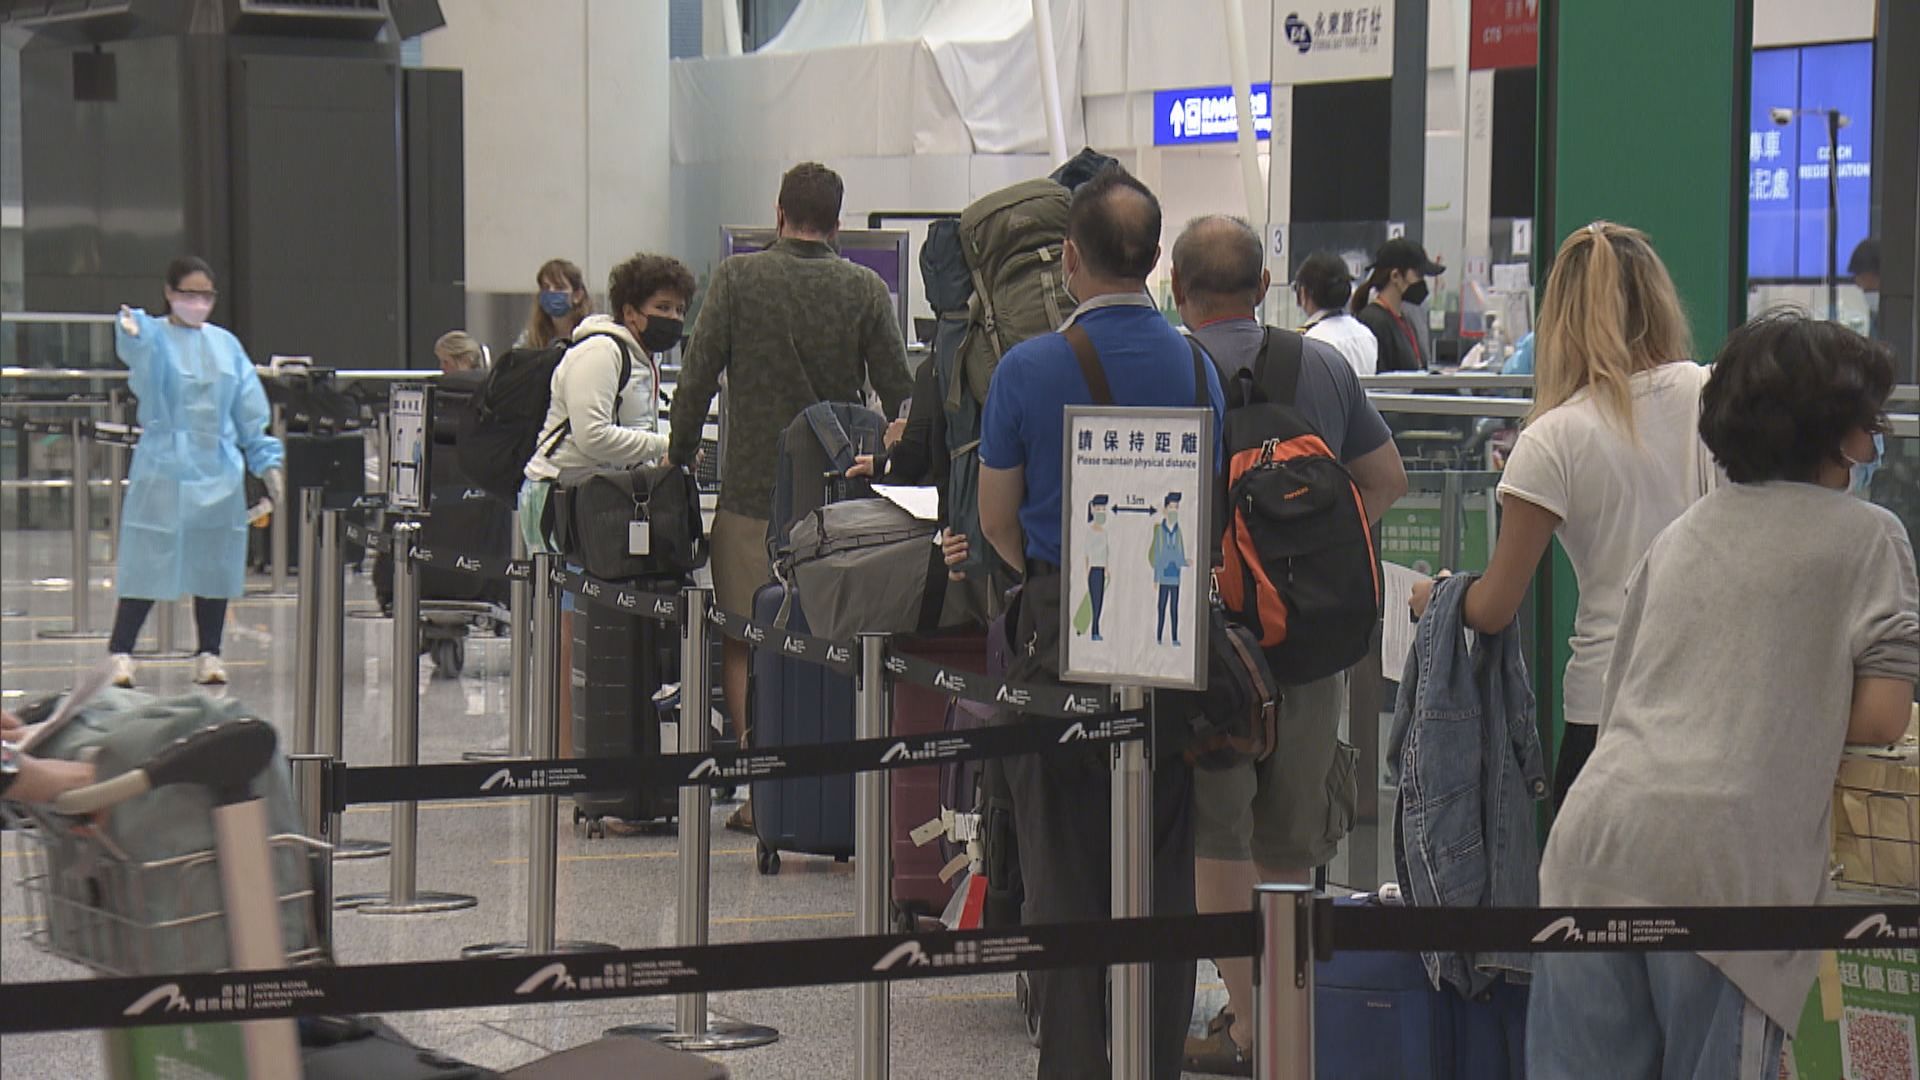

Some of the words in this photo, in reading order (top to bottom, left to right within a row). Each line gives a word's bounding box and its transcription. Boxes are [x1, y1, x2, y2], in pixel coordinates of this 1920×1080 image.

[1314, 8, 1381, 36] 永東旅行社
[1818, 146, 1852, 160] COCH
[1799, 163, 1870, 178] REGISATION
[1750, 167, 1789, 200] 記處
[1273, 229, 1284, 254] 3
[1516, 223, 1527, 247] 1
[1078, 428, 1198, 454] 請保持距離
[1077, 454, 1101, 466] Please
[1102, 456, 1133, 466] maintain
[1134, 456, 1164, 469] physical
[1165, 458, 1197, 469] distance
[253, 989, 324, 999] INTERNATIONAL
